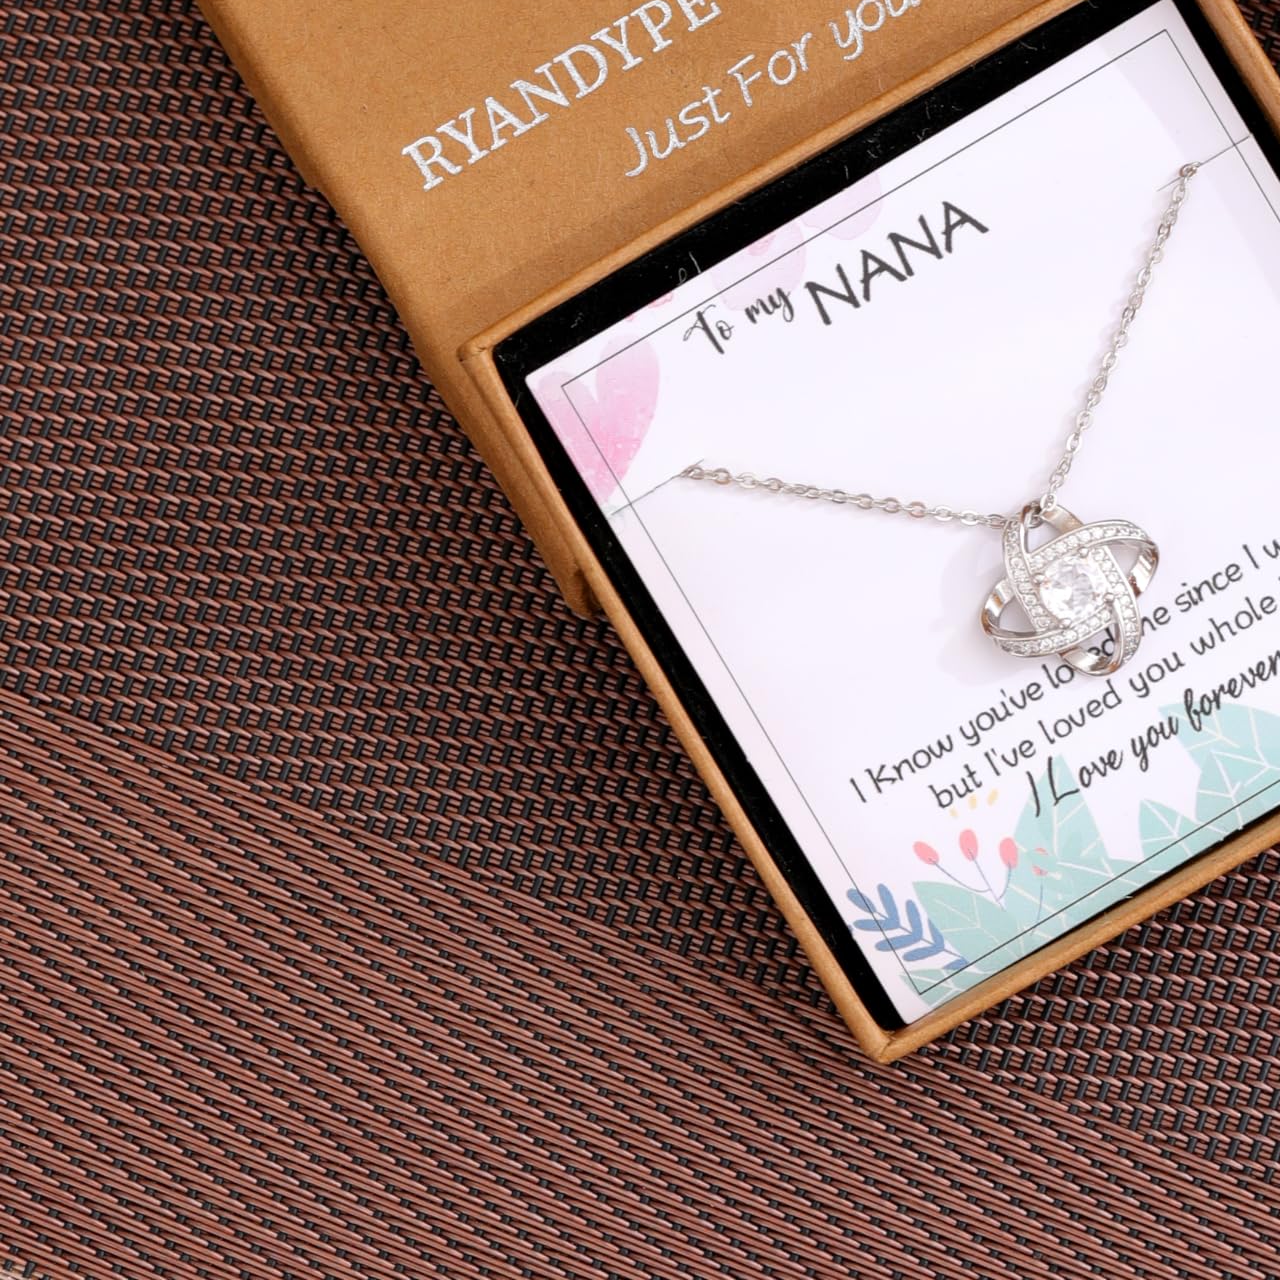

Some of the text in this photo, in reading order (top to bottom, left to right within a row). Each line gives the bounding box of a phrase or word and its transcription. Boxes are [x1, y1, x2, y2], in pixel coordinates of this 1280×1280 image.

[625, 86, 731, 177] Just
[728, 33, 813, 108] For
[683, 201, 989, 355] To my NANA
[849, 778, 867, 803] I
[865, 734, 954, 794] Know
[959, 682, 1044, 746] you've
[1041, 627, 1116, 689] lod
[1175, 563, 1243, 612] since
[1242, 544, 1260, 569] I
[928, 763, 982, 808] but
[984, 739, 1037, 776] I've
[1038, 679, 1122, 744] loved
[1129, 652, 1185, 698] you
[1190, 596, 1278, 656] whole
[1026, 771, 1041, 818] I
[1047, 749, 1123, 806] Love
[1131, 716, 1180, 772] you
